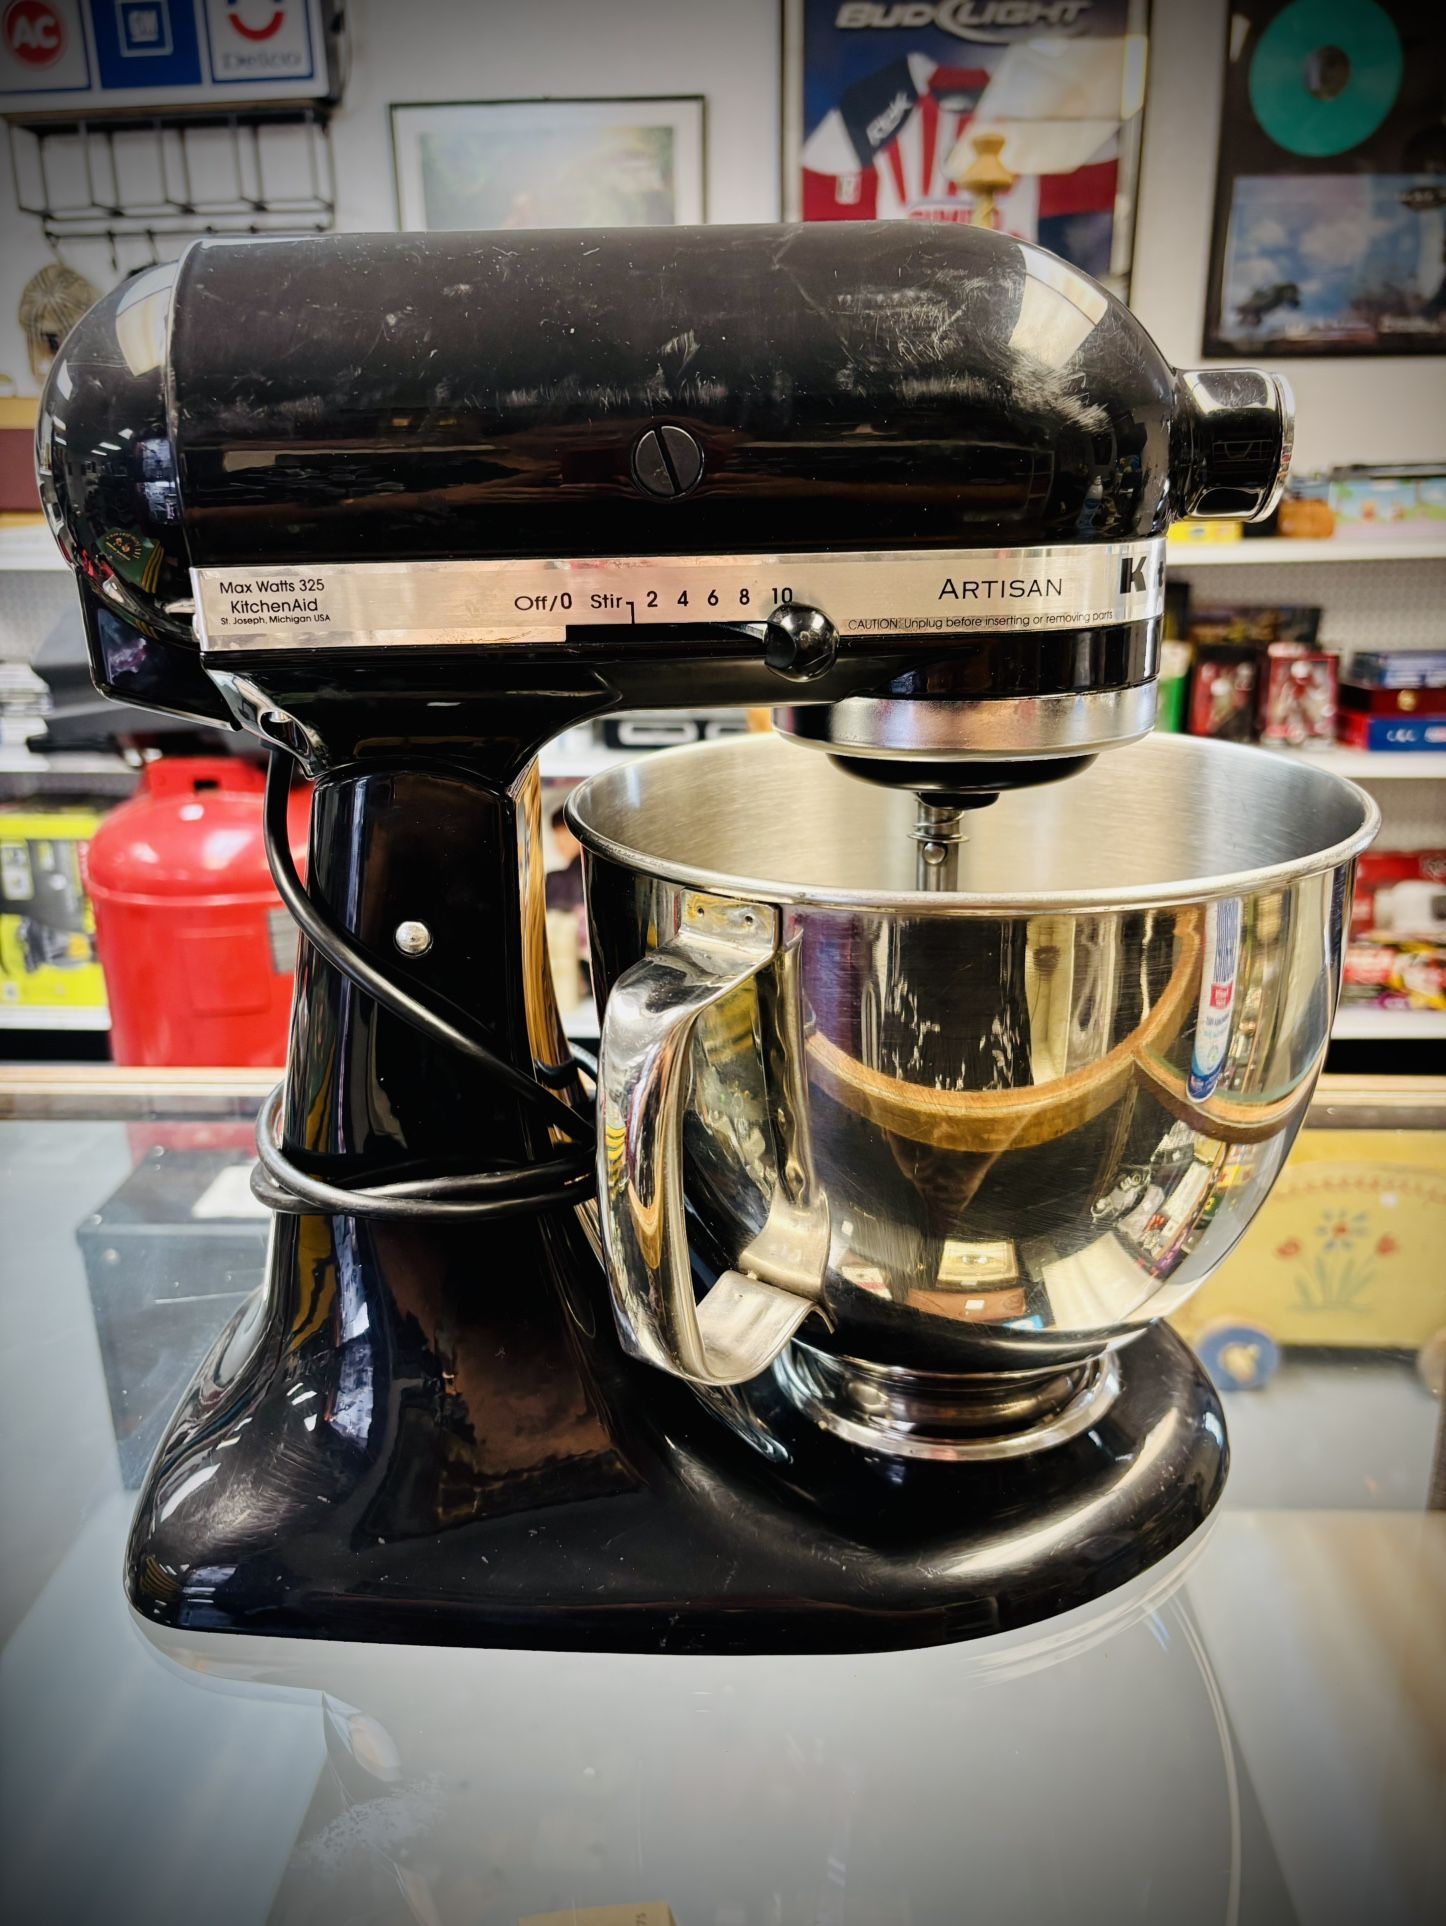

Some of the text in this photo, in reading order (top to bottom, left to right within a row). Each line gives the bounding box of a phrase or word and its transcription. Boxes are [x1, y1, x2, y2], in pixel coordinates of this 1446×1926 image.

[12, 15, 59, 49] AC
[220, 579, 325, 594] Max Watts 325
[938, 578, 1062, 600] ARTISAN
[231, 598, 318, 614] KitchenAid
[514, 587, 793, 611] Off/0 Stir 2 4 6 8 10
[220, 613, 331, 626] St. Joseph, Michigan USA
[904, 618, 943, 630] Unplug
[946, 616, 982, 628] before
[985, 614, 1030, 627] inserting
[1032, 615, 1043, 625] or
[1045, 611, 1091, 624] removing
[1092, 610, 1113, 621] parts
